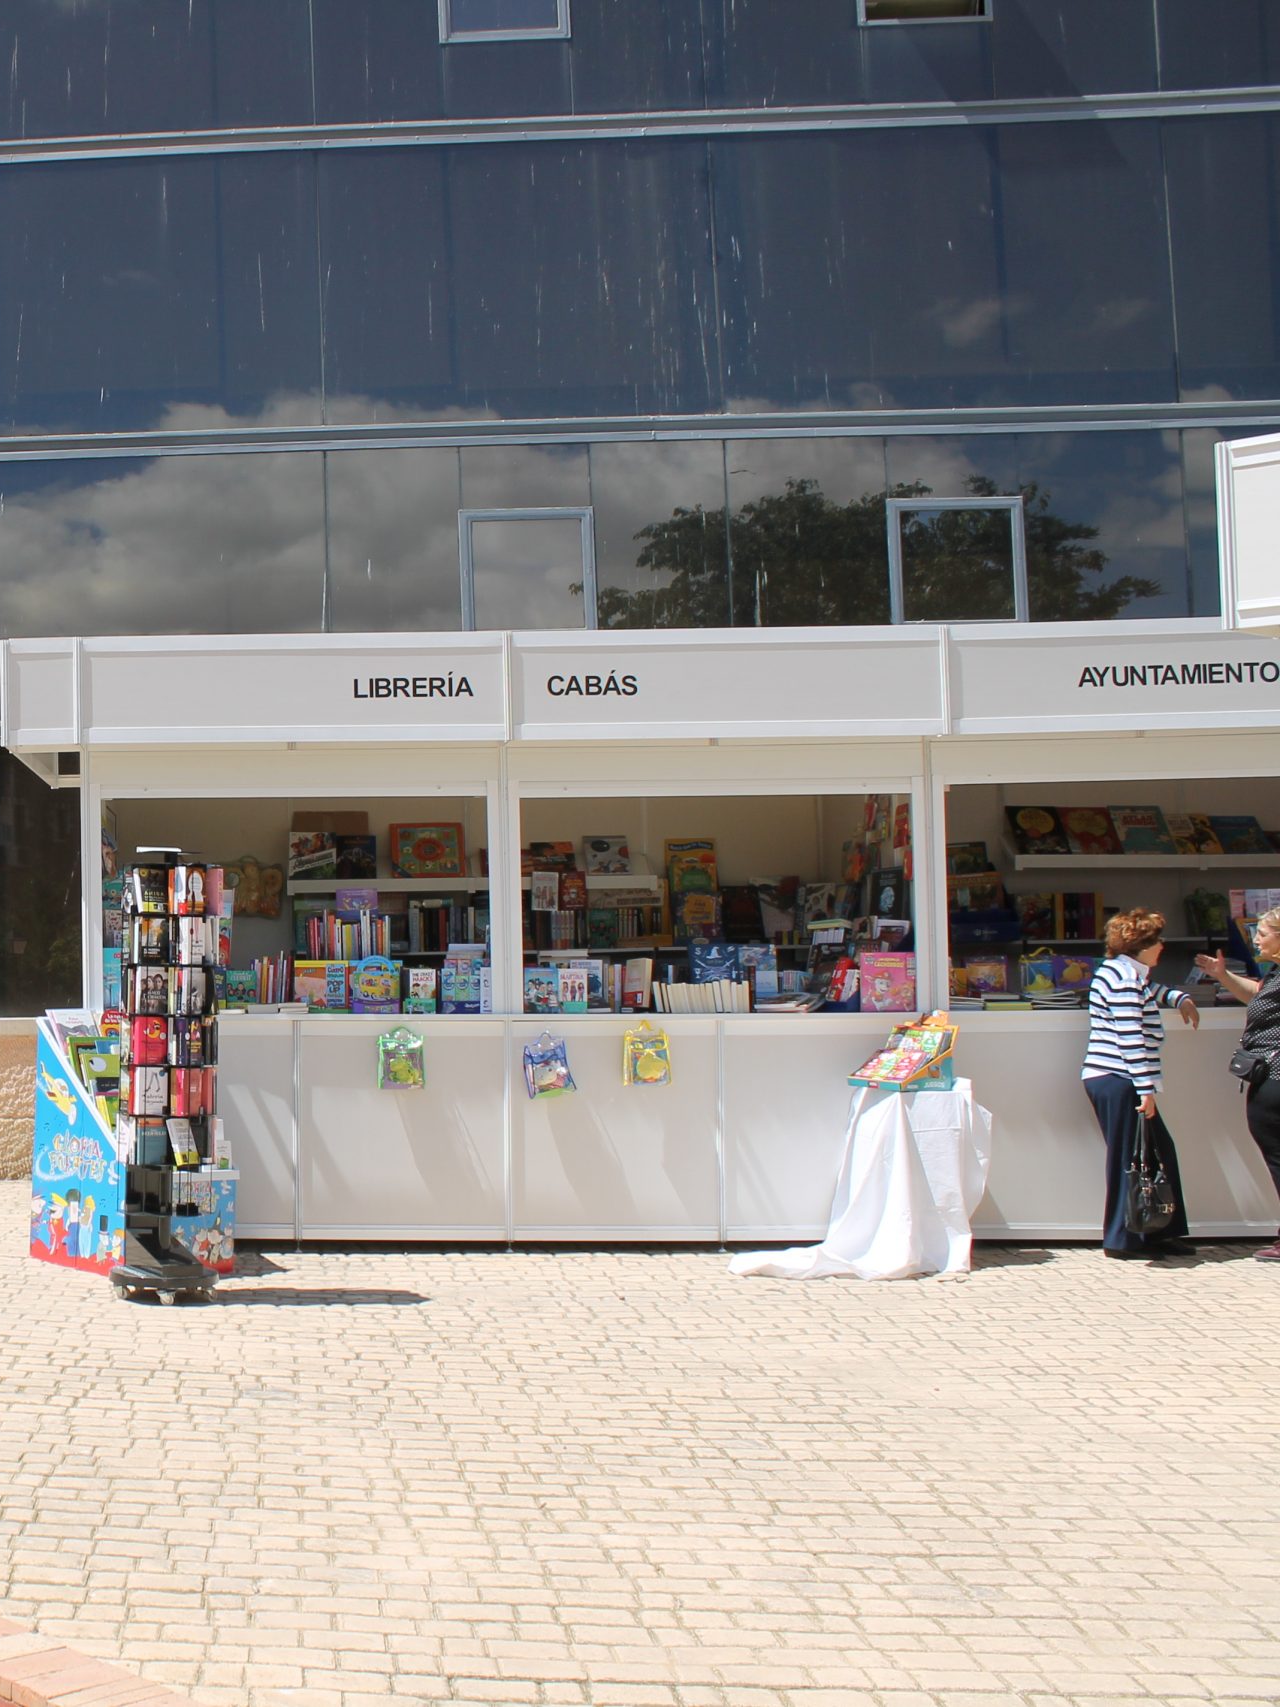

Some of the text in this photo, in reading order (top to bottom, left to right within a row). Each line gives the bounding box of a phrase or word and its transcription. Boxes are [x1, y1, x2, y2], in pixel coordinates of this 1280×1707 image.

[353, 669, 639, 699] LIBRERÍA CABÁS
[1078, 661, 1280, 688] AYUNTAMIENTO
[52, 1129, 103, 1160] GLORIA
[48, 1150, 108, 1184] FUERTES
